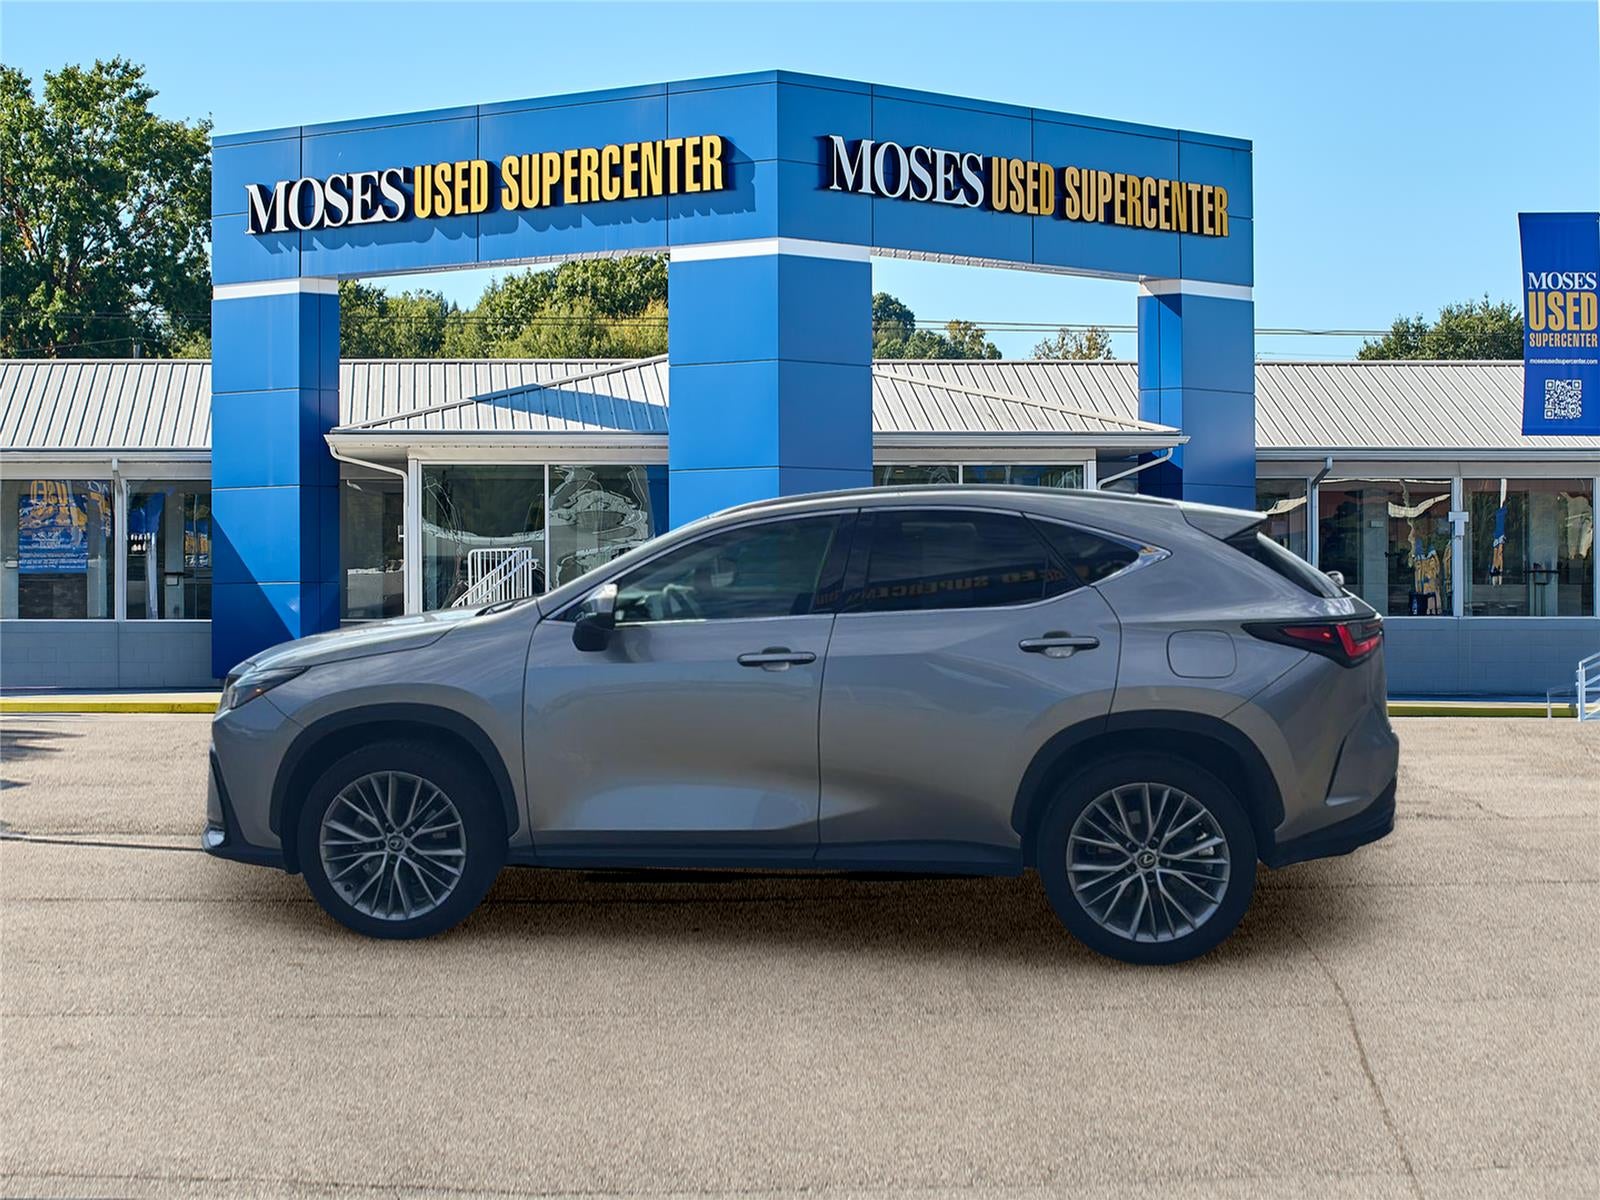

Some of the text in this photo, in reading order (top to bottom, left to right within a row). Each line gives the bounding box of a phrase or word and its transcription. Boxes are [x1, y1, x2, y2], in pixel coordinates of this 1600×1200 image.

[245, 134, 723, 234] MOSES USED SUPERCENTER
[829, 134, 1229, 237] MOSES USED SUPERCENTER
[1528, 271, 1597, 290] MOSES
[1528, 291, 1598, 331] USED
[1529, 332, 1598, 348] SUPERCENTER
